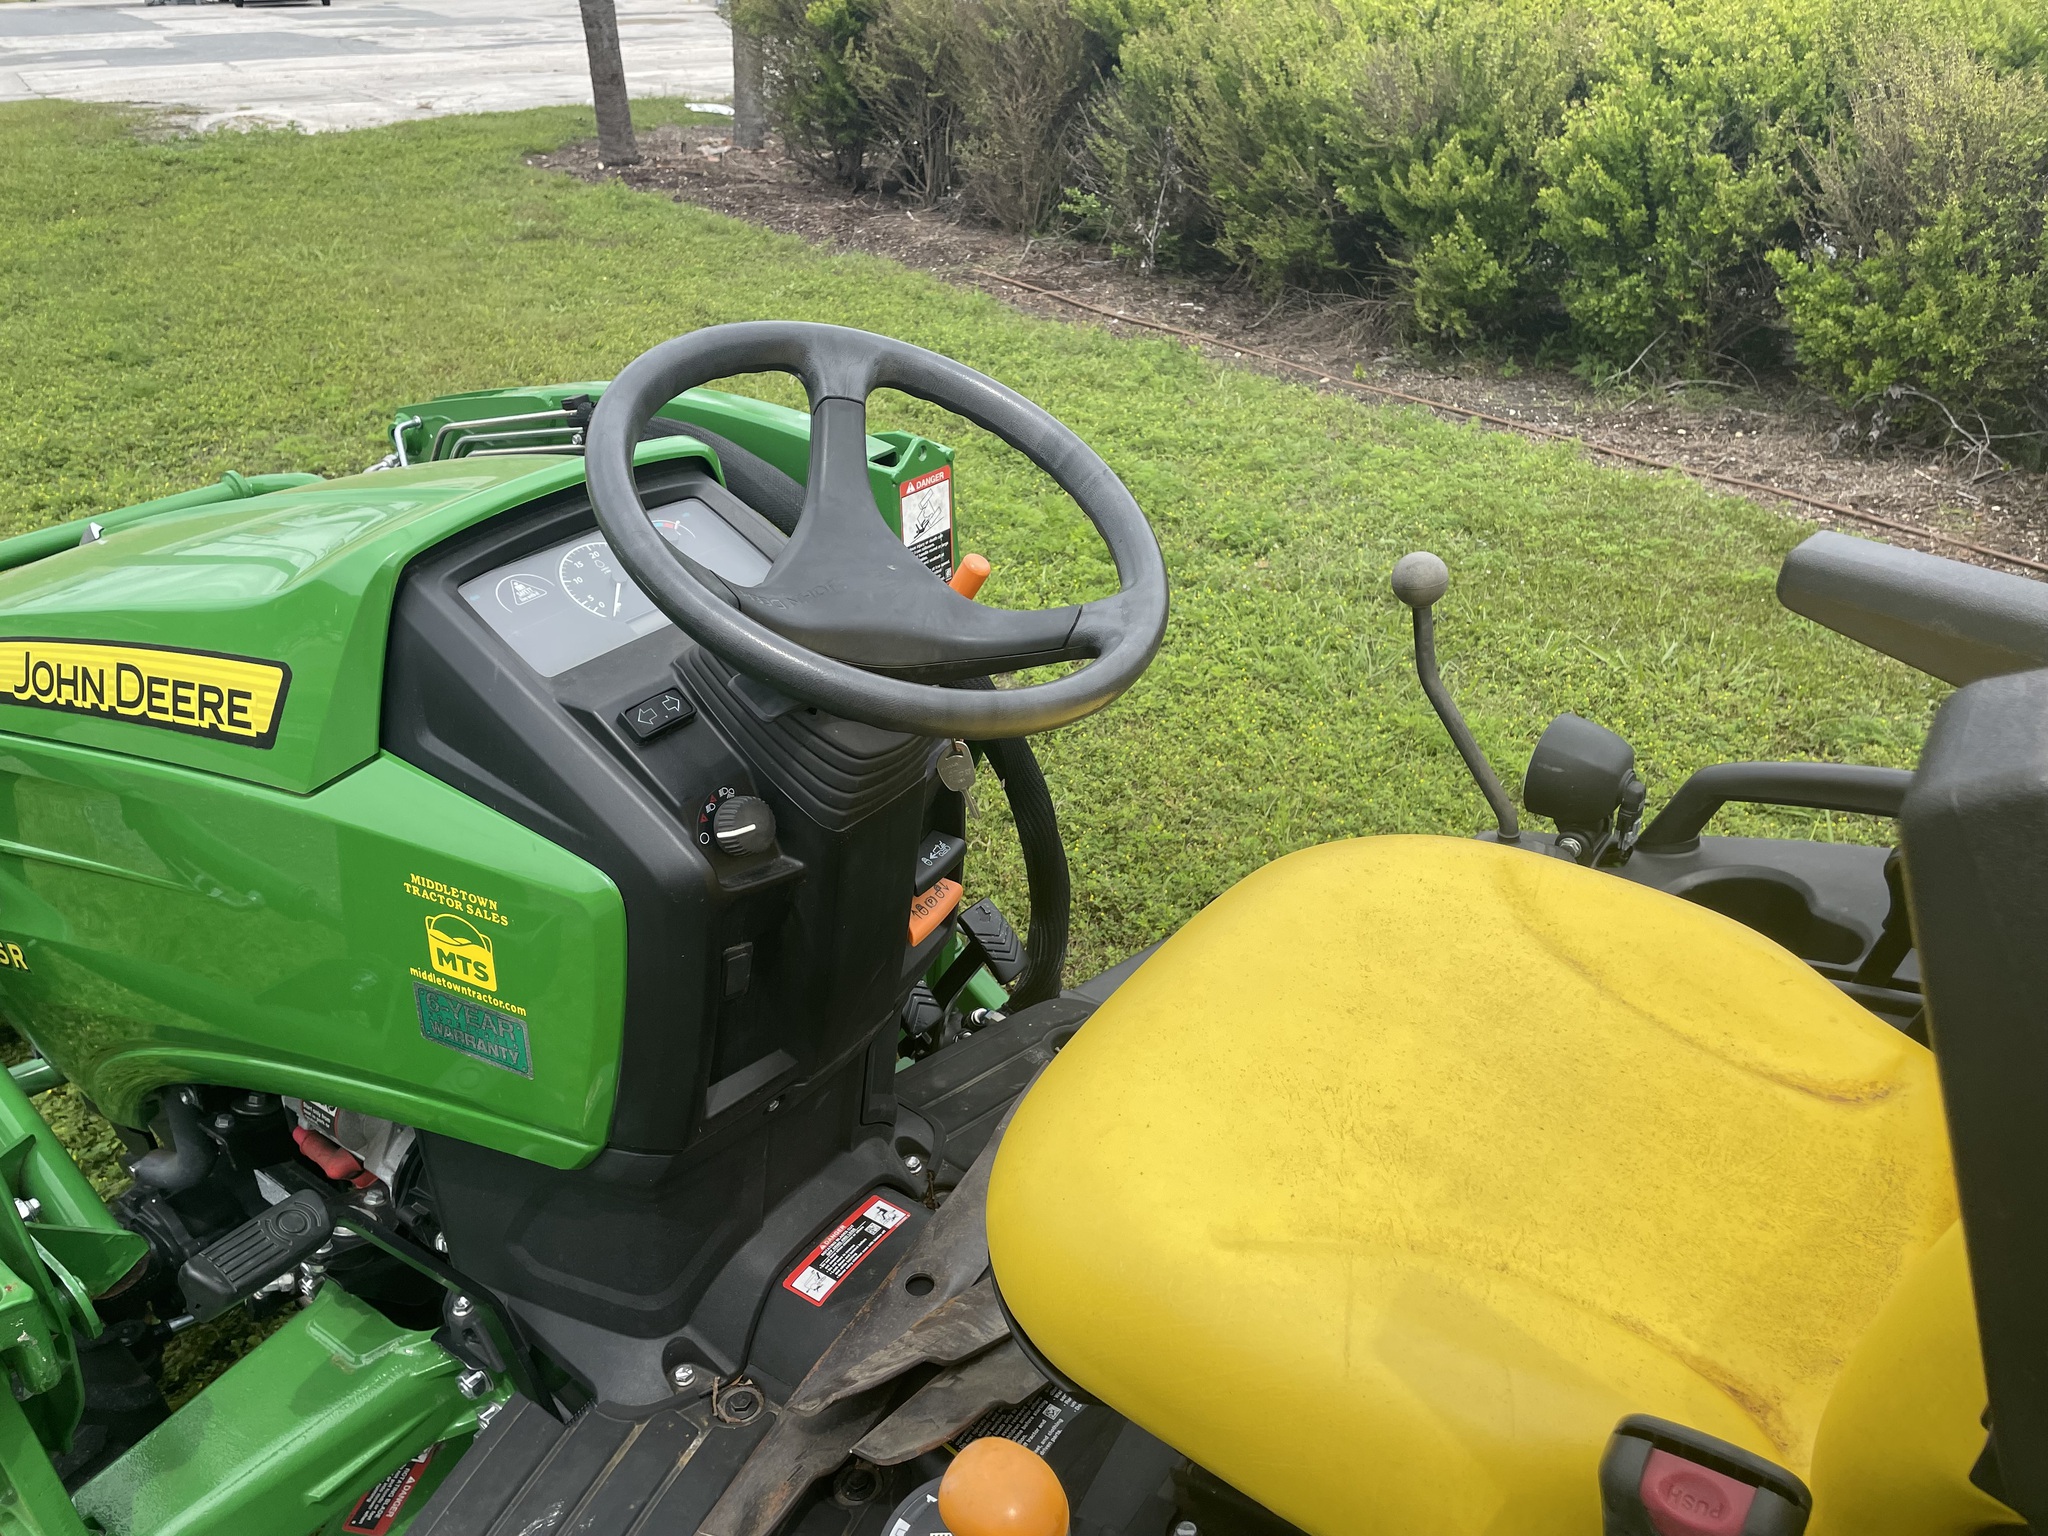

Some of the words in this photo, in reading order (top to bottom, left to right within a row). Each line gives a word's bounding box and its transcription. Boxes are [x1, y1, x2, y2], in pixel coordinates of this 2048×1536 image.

[916, 471, 945, 490] DANGER
[589, 551, 600, 559] 20
[587, 594, 594, 602] 5
[14, 651, 105, 705] JOHN
[116, 662, 252, 730] DEERE
[403, 882, 463, 911] TRACTOR
[466, 904, 509, 927] SALES
[410, 873, 498, 911] MIDDLETOWN
[437, 947, 489, 982] MTS
[409, 966, 527, 1017] middletowntractor.com
[426, 992, 516, 1041] 6-YEAR
[430, 1018, 521, 1065] WARRANTY
[824, 1225, 847, 1245] DANGER
[386, 1485, 411, 1518] DANGER
[1667, 1485, 1725, 1519] PUSH
